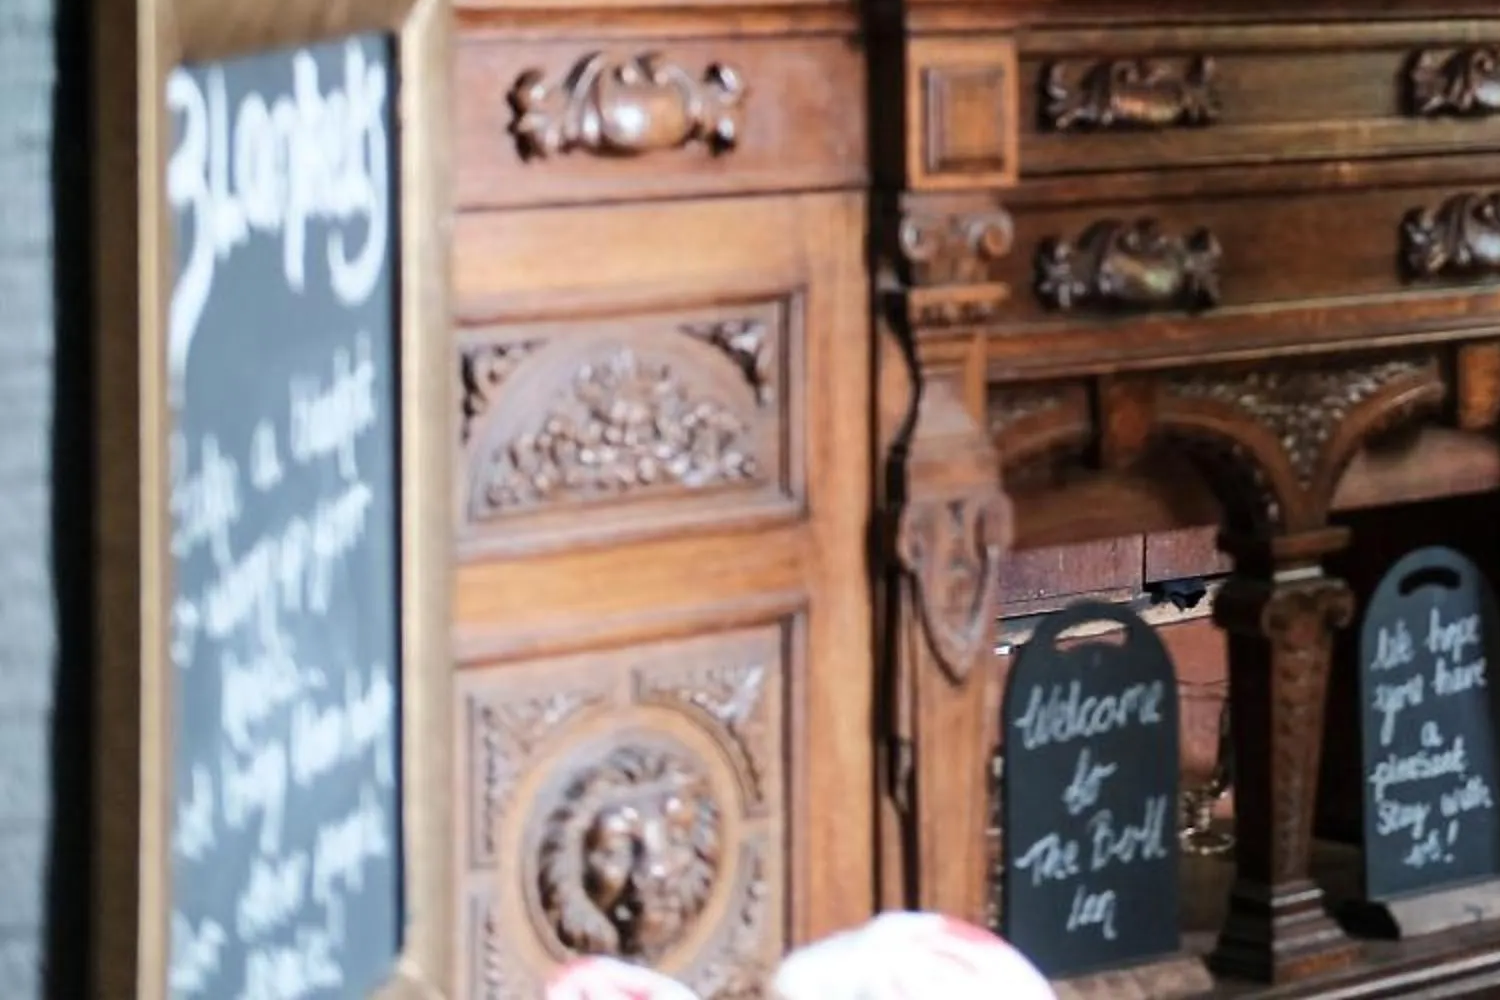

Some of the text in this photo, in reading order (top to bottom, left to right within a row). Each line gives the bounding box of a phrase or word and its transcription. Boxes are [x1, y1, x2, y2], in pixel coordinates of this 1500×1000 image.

[1014, 680, 1164, 750] Welcome
[1420, 720, 1443, 747] a
[1061, 747, 1118, 815] to
[1014, 832, 1080, 887] The
